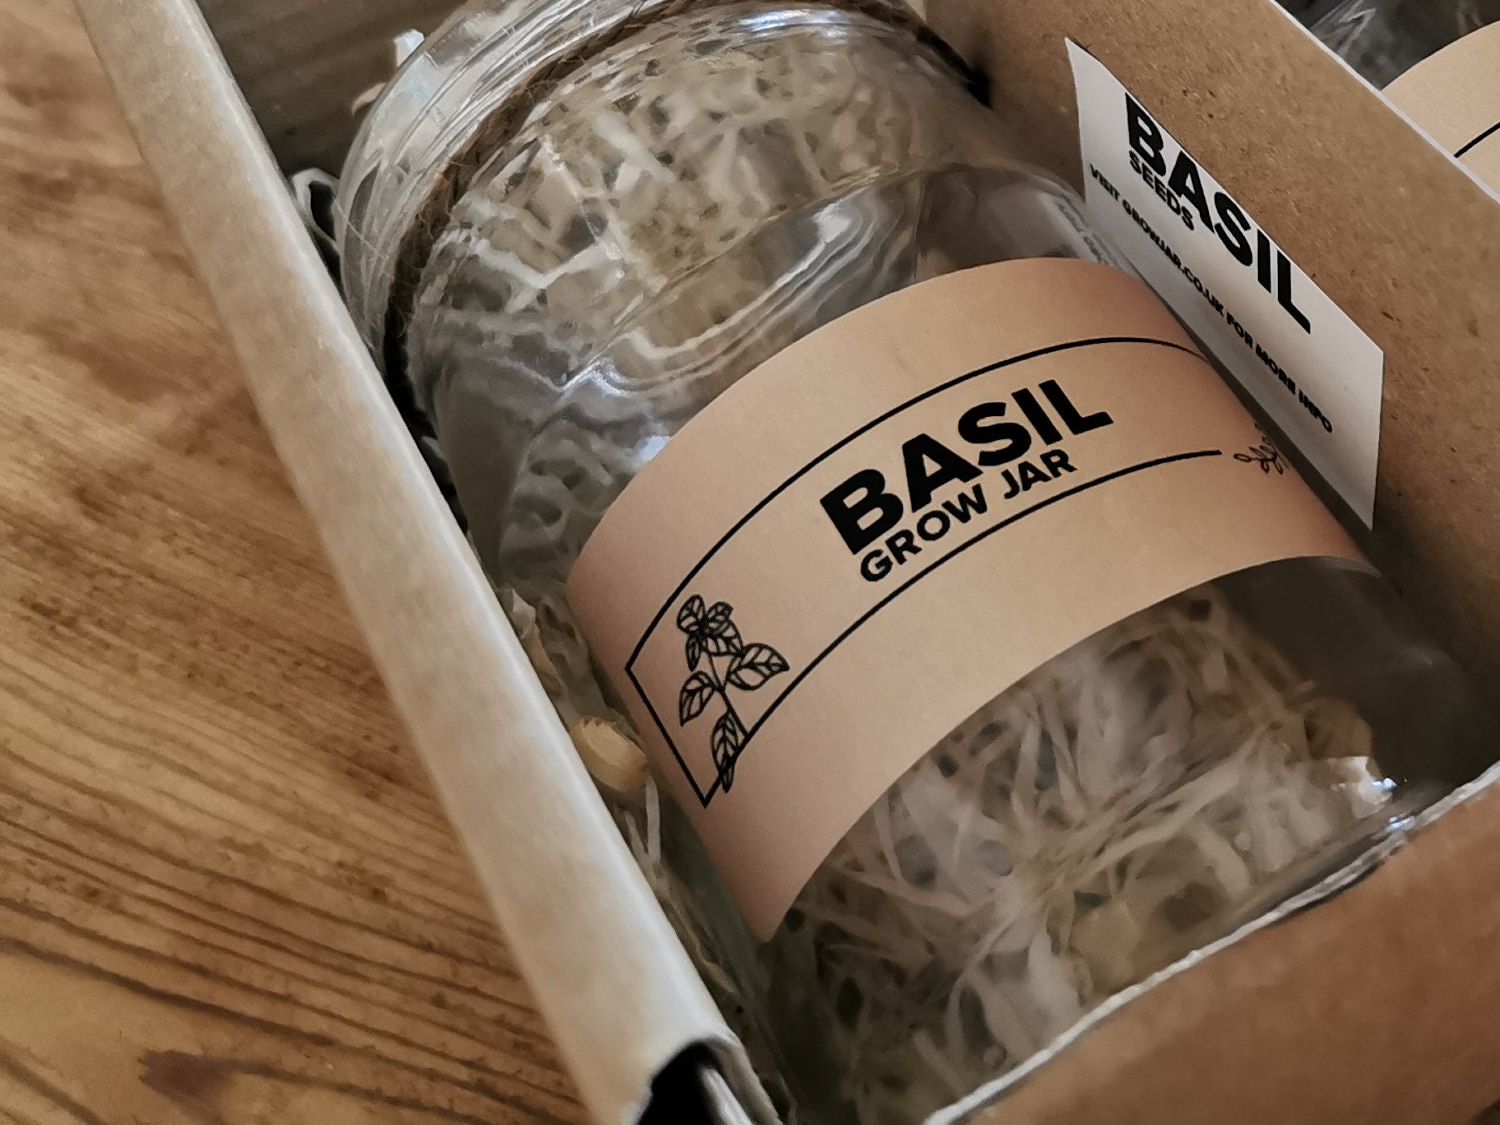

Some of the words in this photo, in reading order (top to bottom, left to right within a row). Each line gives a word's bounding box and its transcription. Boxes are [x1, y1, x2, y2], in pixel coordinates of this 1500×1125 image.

[1124, 91, 1311, 335] BASIL
[1128, 150, 1195, 231] SEEDS
[1090, 163, 1121, 202] VISIT
[1227, 310, 1253, 349] FOR
[1255, 343, 1296, 395] MORE
[1298, 388, 1332, 433] INFO
[819, 378, 1115, 556] BASIL
[860, 483, 988, 582] GROW
[1000, 448, 1078, 499] JAR
